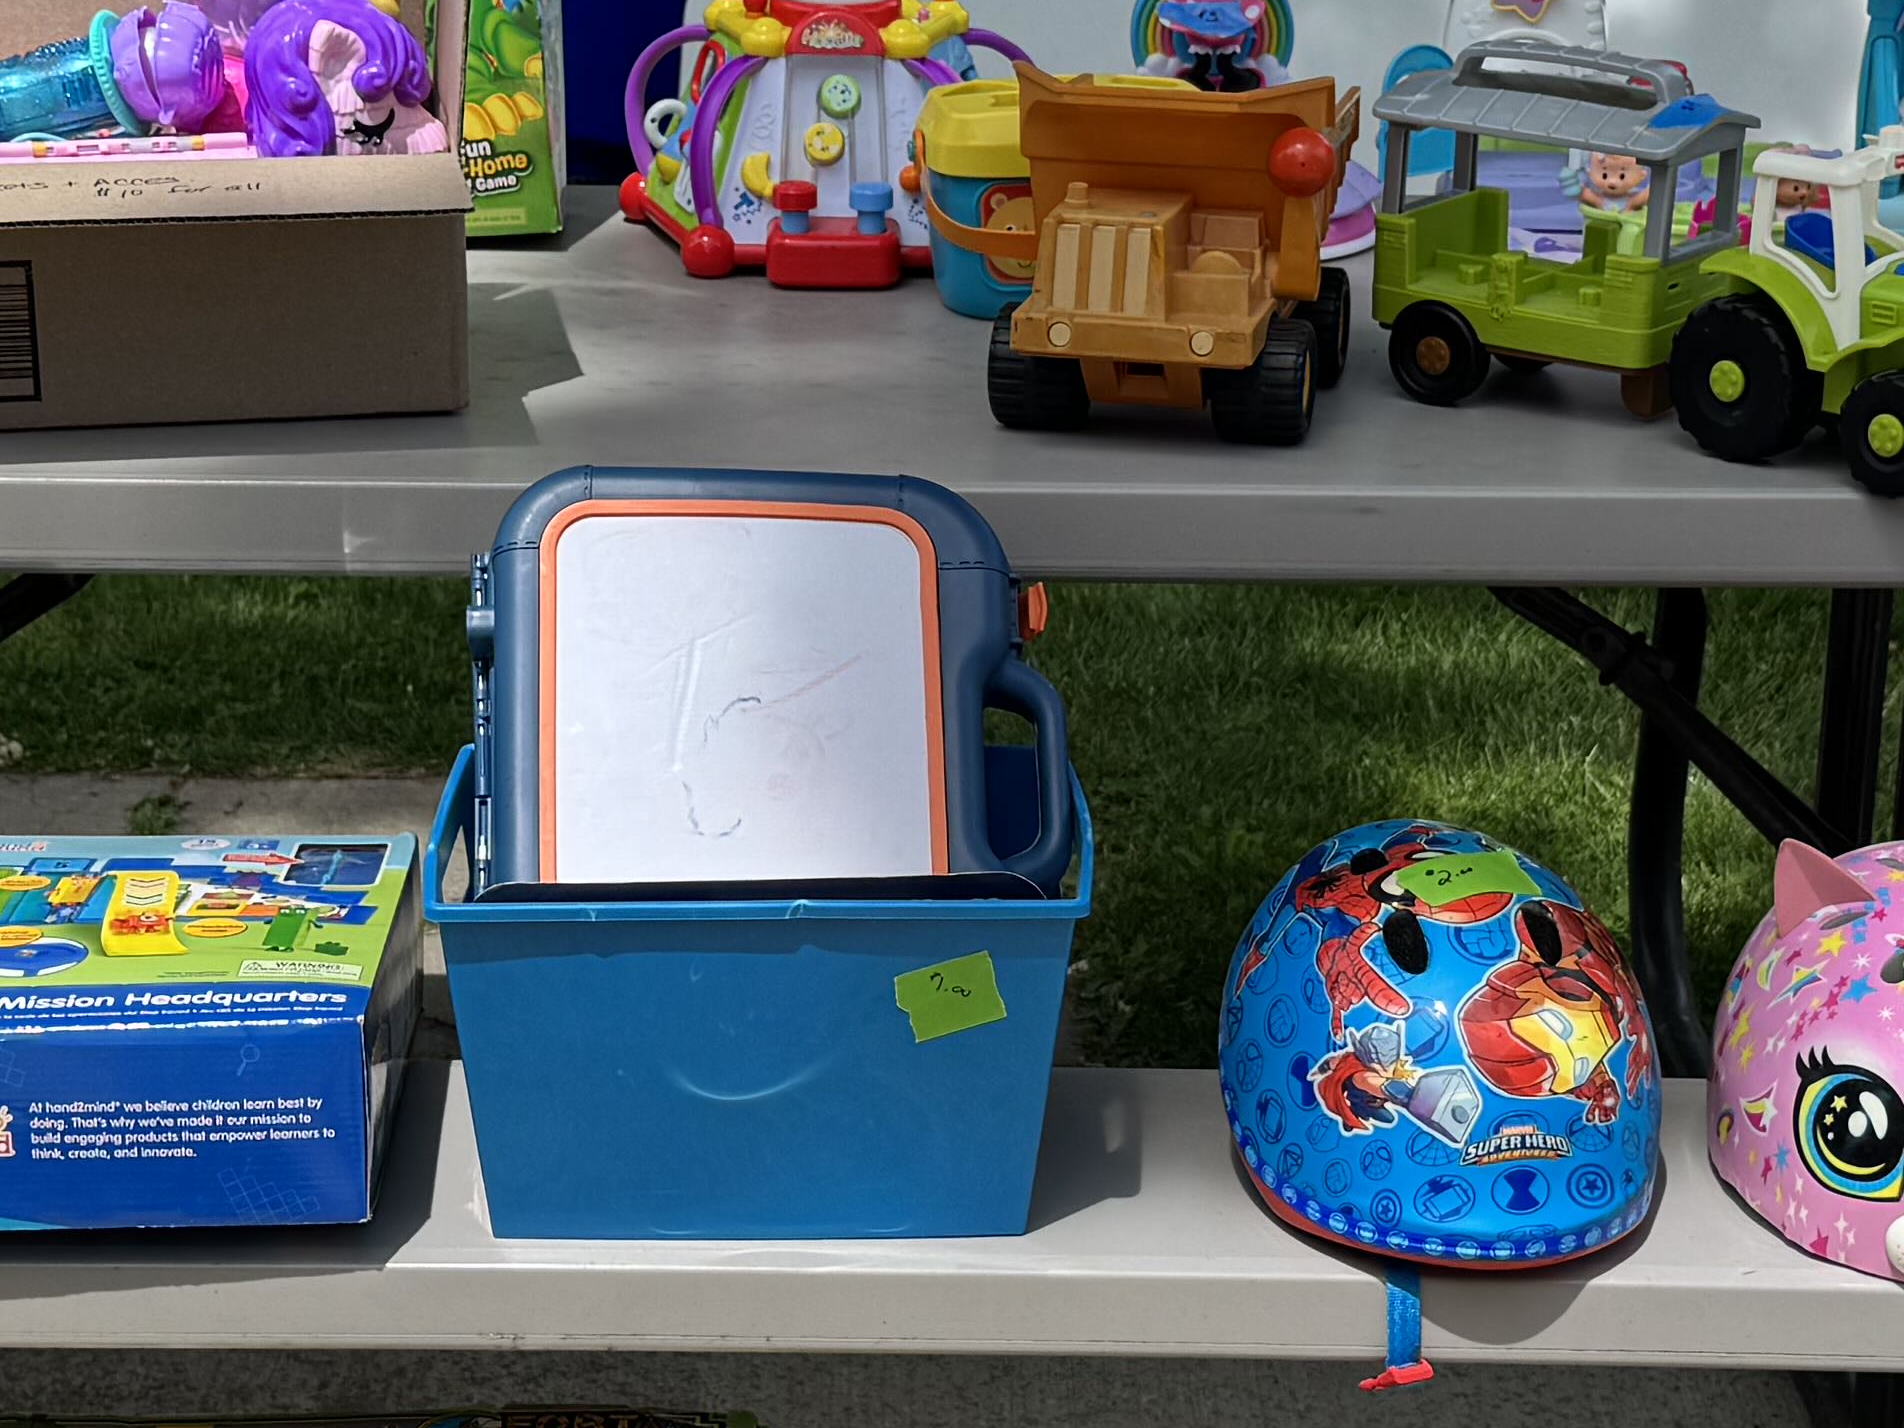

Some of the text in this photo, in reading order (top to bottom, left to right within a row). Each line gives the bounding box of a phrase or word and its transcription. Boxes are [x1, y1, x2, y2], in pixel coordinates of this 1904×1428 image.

[475, 175, 517, 191] Game
[124, 991, 348, 1009] Headquarters
[29, 1102, 43, 1113] At
[123, 1102, 142, 1112] we
[145, 1100, 189, 1112] believe
[192, 1099, 240, 1112] children
[243, 1098, 274, 1110] learn
[277, 1097, 305, 1110] best
[306, 1096, 324, 1111] by
[30, 1112, 312, 1131] doing. That's why we've made it our mission to
[31, 1128, 335, 1147] build engaging products that empower learners to
[31, 1146, 197, 1160] think, create, and innovate.
[1465, 1134, 1568, 1160] SUPER HERO
